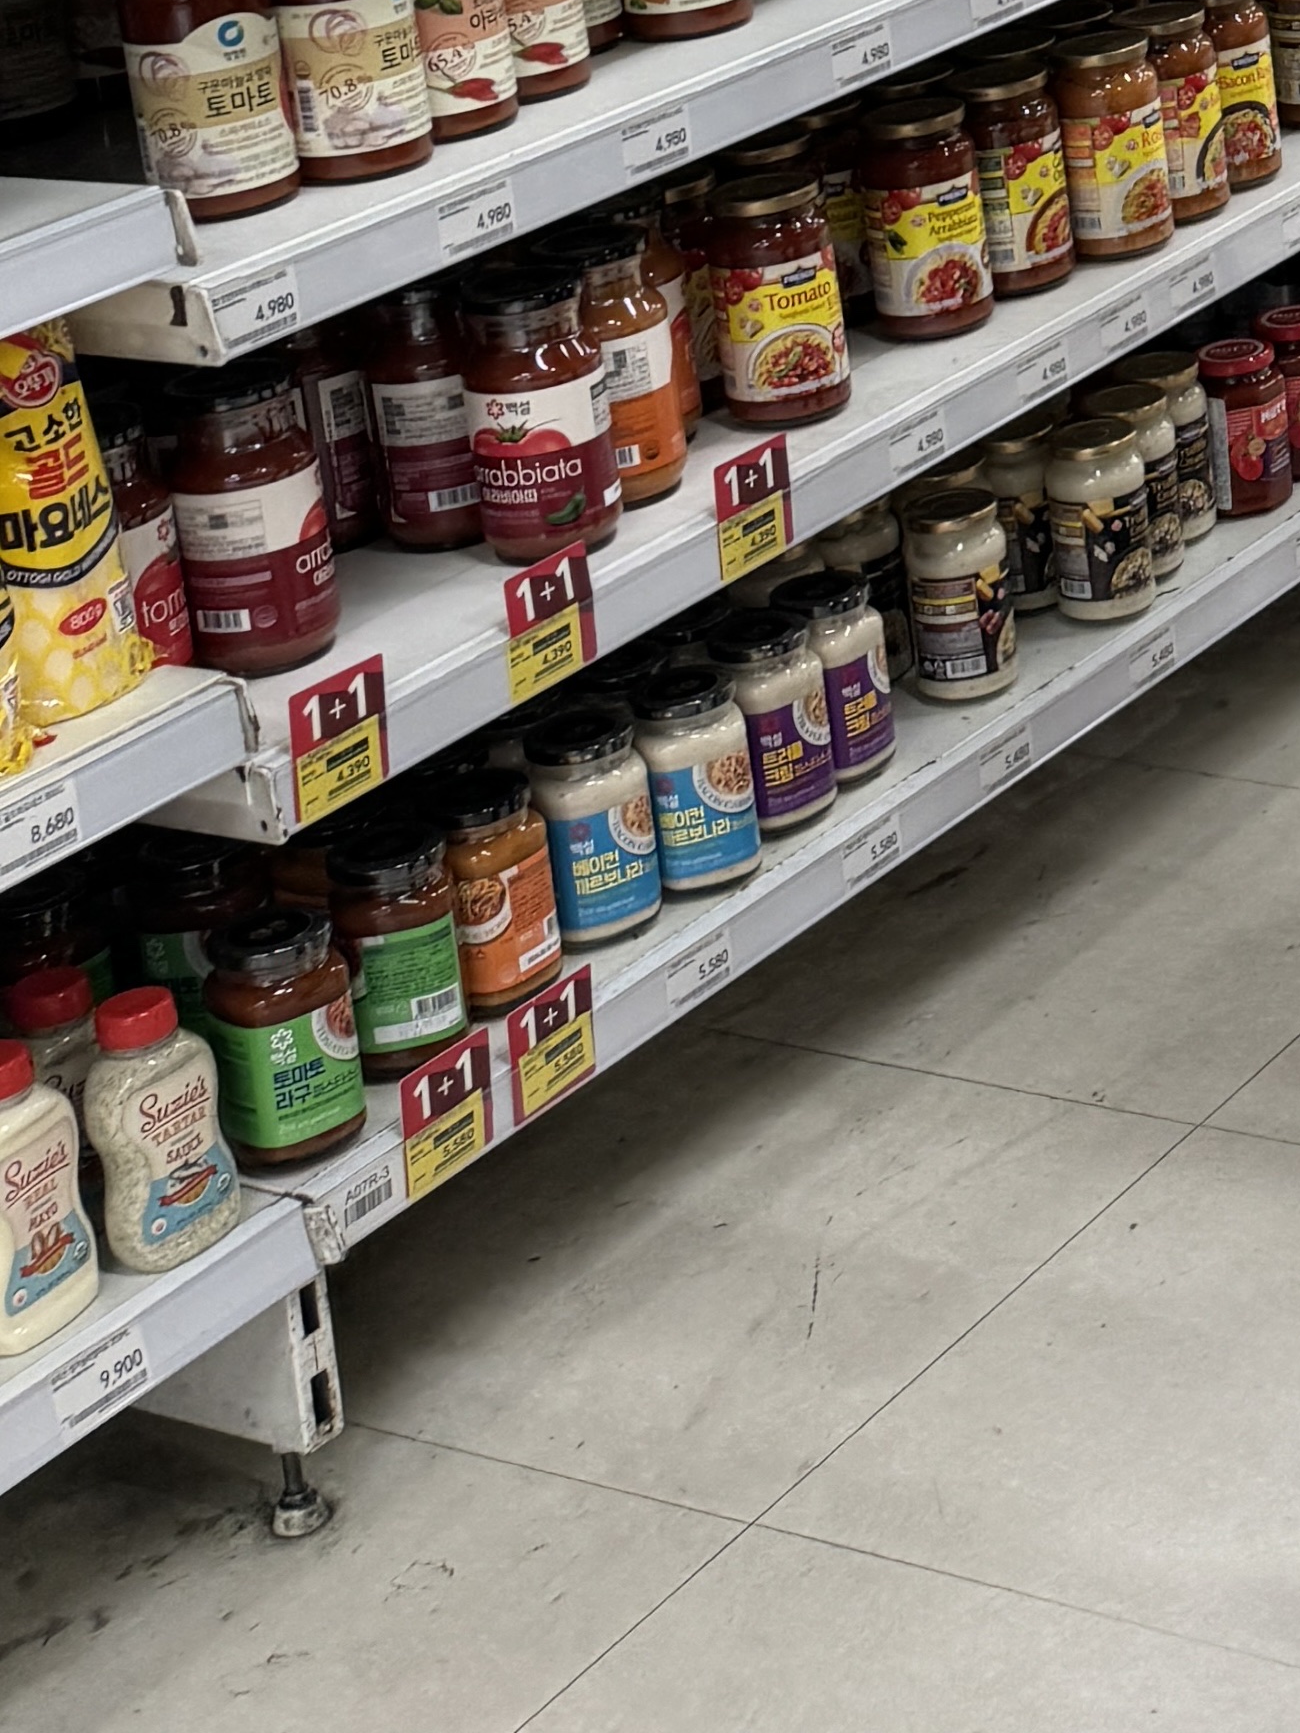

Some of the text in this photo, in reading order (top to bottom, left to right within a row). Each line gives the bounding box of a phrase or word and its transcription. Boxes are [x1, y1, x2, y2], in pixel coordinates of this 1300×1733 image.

[861, 43, 889, 64] 4,980
[205, 83, 276, 119] 토마토
[653, 125, 688, 152] 4,980
[476, 202, 512, 230] 4,980
[254, 292, 295, 324] 4,980
[764, 279, 831, 312] Tomato
[506, 400, 530, 416] 백설
[6, 398, 81, 452] 고소한
[27, 433, 89, 500] 골드
[724, 448, 774, 506] 1+1
[516, 557, 575, 622] 1+1
[542, 640, 572, 666] 4,390
[303, 672, 368, 739] 1+1
[334, 752, 372, 782] 4,390
[30, 805, 75, 844] 8,680
[871, 831, 898, 861] 5,580
[573, 851, 619, 877] 베이컨
[697, 949, 729, 980] 5,580
[519, 974, 577, 1047] 1+1
[274, 1058, 325, 1089] 토마토
[553, 1045, 584, 1072] 5,580
[275, 1085, 310, 1111] 라구
[413, 1047, 473, 1120] 1+1
[139, 1075, 210, 1133] Suzie's
[152, 1107, 207, 1147] TARTAR
[166, 1134, 204, 1165] SAUCE
[442, 1131, 476, 1160] 5,580
[4, 1140, 70, 1197] Suzie's
[345, 1166, 390, 1205] A07R-3
[29, 1204, 58, 1231] MAYO
[100, 1348, 143, 1390] 9,900
